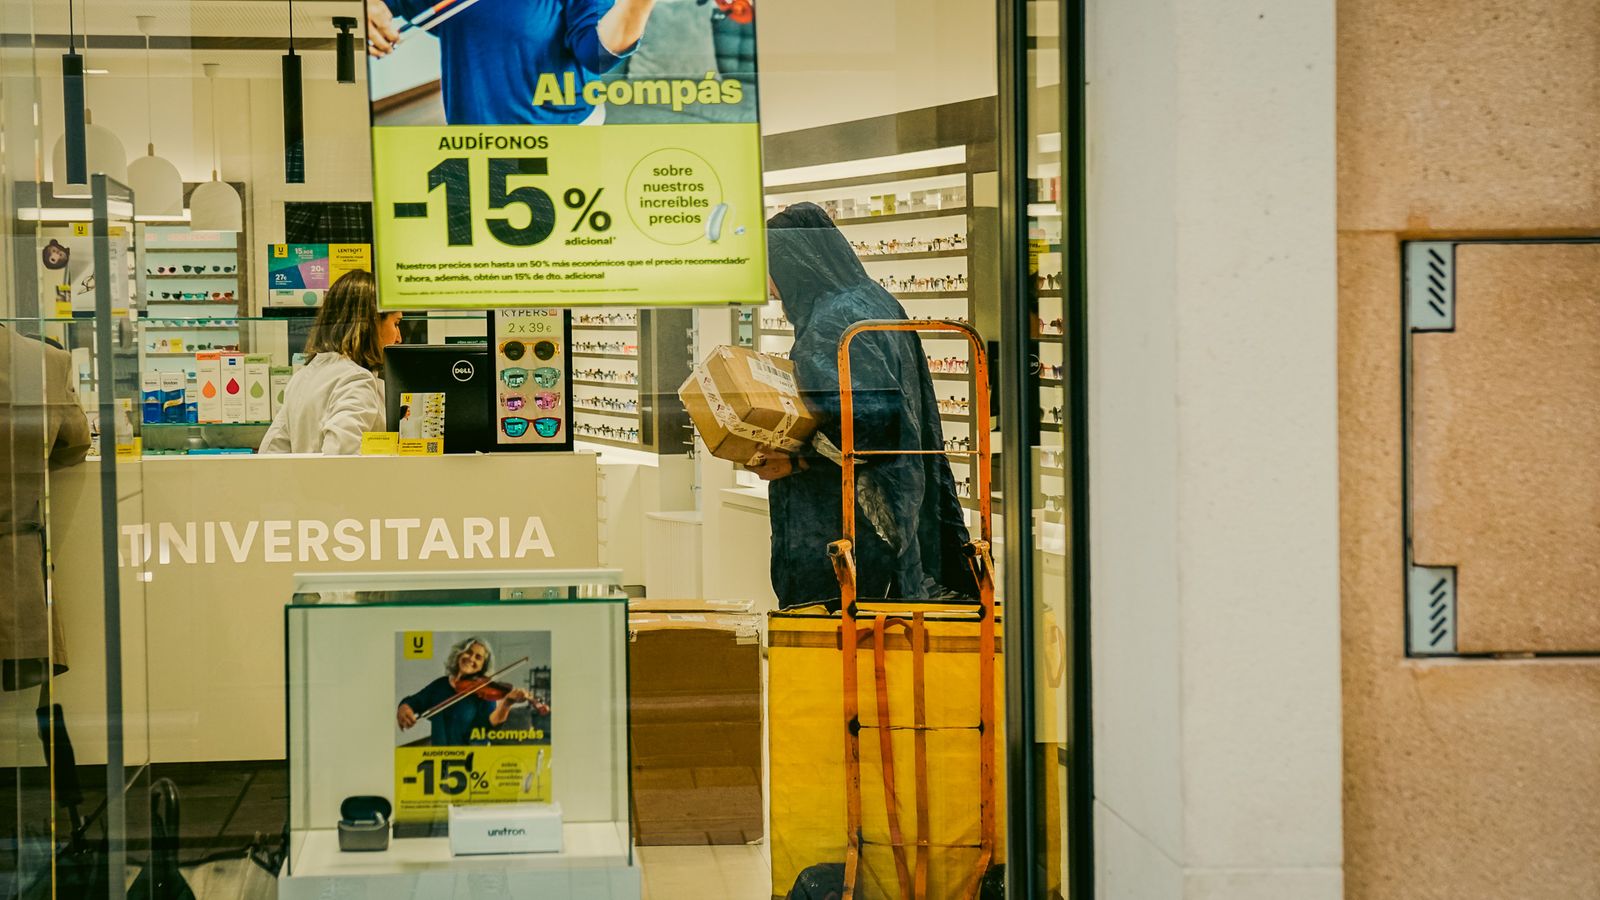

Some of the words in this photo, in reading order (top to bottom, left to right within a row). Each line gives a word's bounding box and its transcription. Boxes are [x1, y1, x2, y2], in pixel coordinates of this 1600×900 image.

[532, 71, 576, 106] Al
[583, 71, 743, 112] compás
[438, 132, 549, 150] AUDÍFONOS
[652, 164, 694, 177] sobre
[642, 181, 705, 193] nuestros
[639, 195, 709, 208] increíbles
[649, 211, 702, 226] precios
[396, 262, 437, 271] Nuestros
[438, 262, 472, 271] precios
[473, 262, 490, 270] son
[490, 260, 516, 269] hasta
[529, 260, 551, 269] 50%
[551, 260, 571, 269] más
[571, 258, 626, 268] económicos
[626, 258, 645, 268] que
[645, 257, 654, 266] el
[655, 258, 683, 267] precio
[396, 275, 403, 283] Y
[404, 274, 433, 284] ahora,
[434, 273, 472, 283] además,
[473, 273, 501, 282] obtén
[501, 274, 513, 282] un
[514, 273, 532, 282] 15%
[532, 272, 545, 281] de
[545, 272, 564, 281] dto.
[564, 271, 605, 281] adicional
[501, 308, 548, 318] KYPERS
[508, 322, 516, 333] 2
[519, 325, 526, 333] x
[454, 367, 472, 375] DELL
[413, 636, 424, 648] U
[470, 727, 487, 741] Al
[488, 726, 544, 742] compás
[487, 826, 526, 838] unitron
